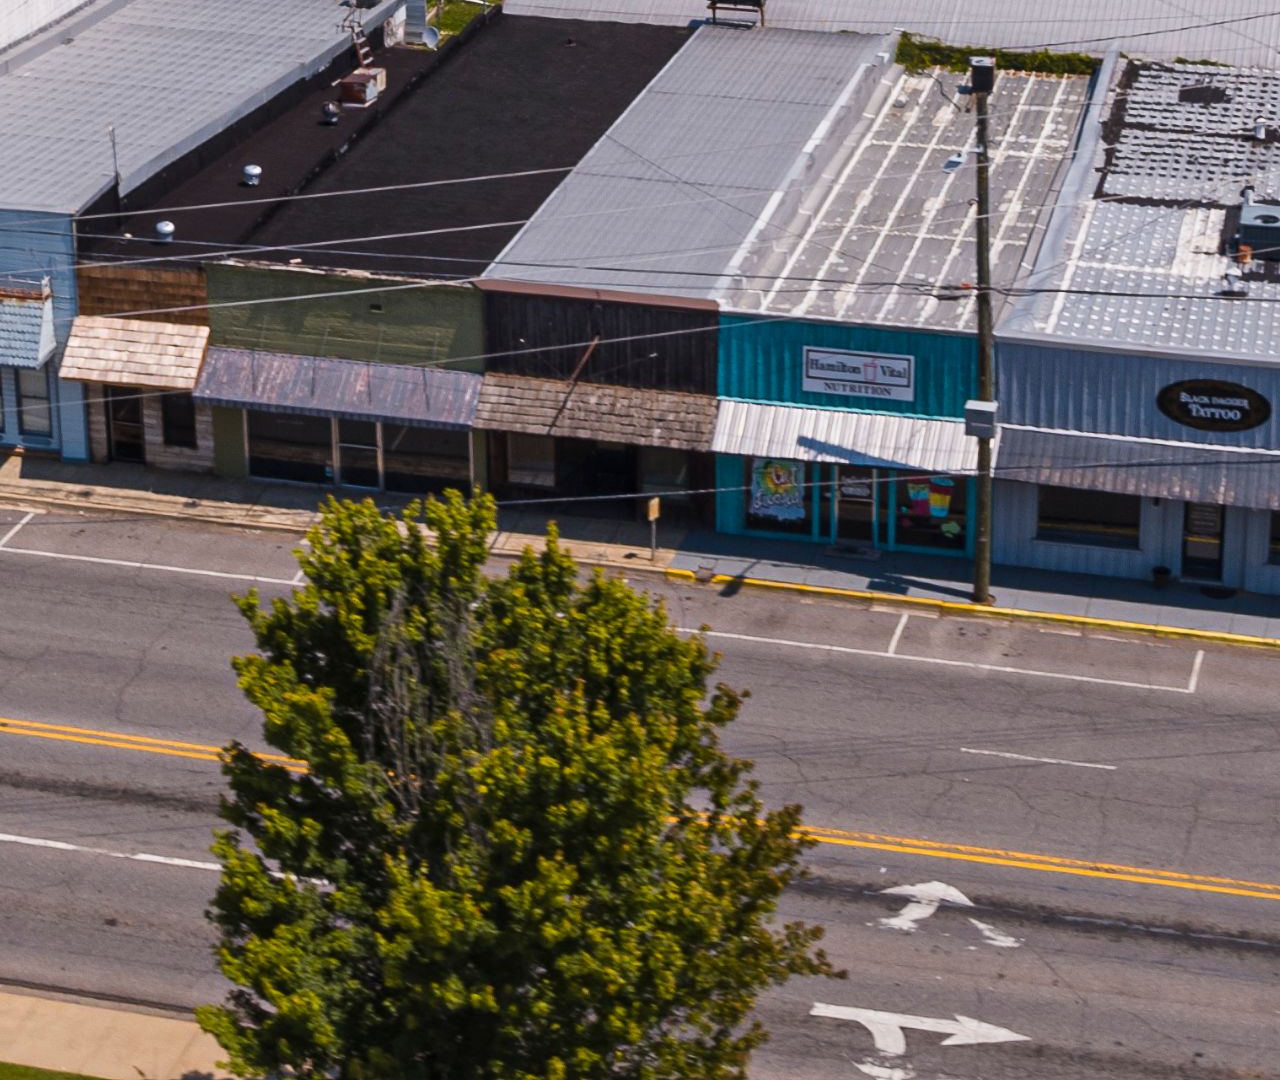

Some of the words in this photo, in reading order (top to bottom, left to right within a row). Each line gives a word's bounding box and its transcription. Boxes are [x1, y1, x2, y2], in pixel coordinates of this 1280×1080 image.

[809, 358, 861, 375] Hamilton
[880, 365, 908, 379] Vital
[823, 382, 892, 396] NUTRITION
[1188, 403, 1241, 420] TATTOO
